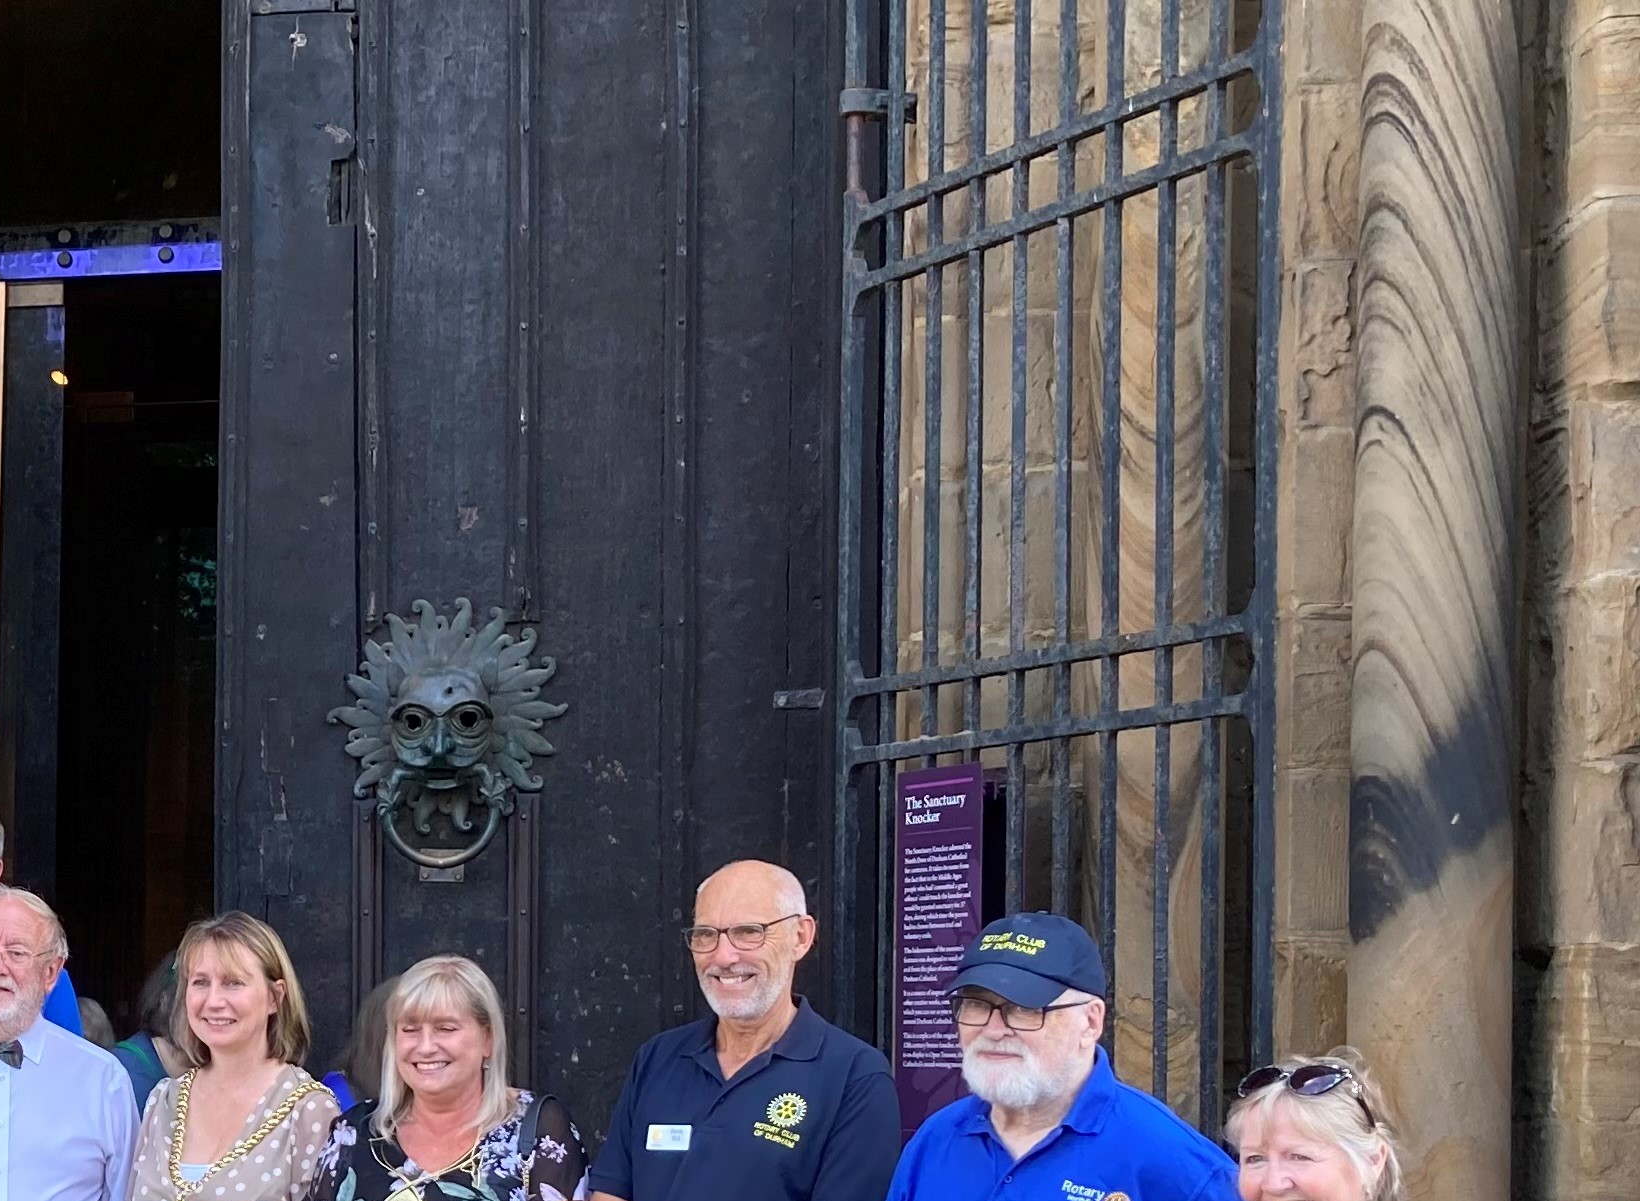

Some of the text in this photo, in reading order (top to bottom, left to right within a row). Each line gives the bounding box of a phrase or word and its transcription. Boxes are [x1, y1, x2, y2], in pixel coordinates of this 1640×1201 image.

[905, 794, 966, 810] The Sanctuary
[905, 809, 941, 825] Knocker
[982, 932, 1046, 948] ROTARY CLUB
[993, 942, 1037, 955] DURHAM
[1061, 1179, 1105, 1201] Rotary
